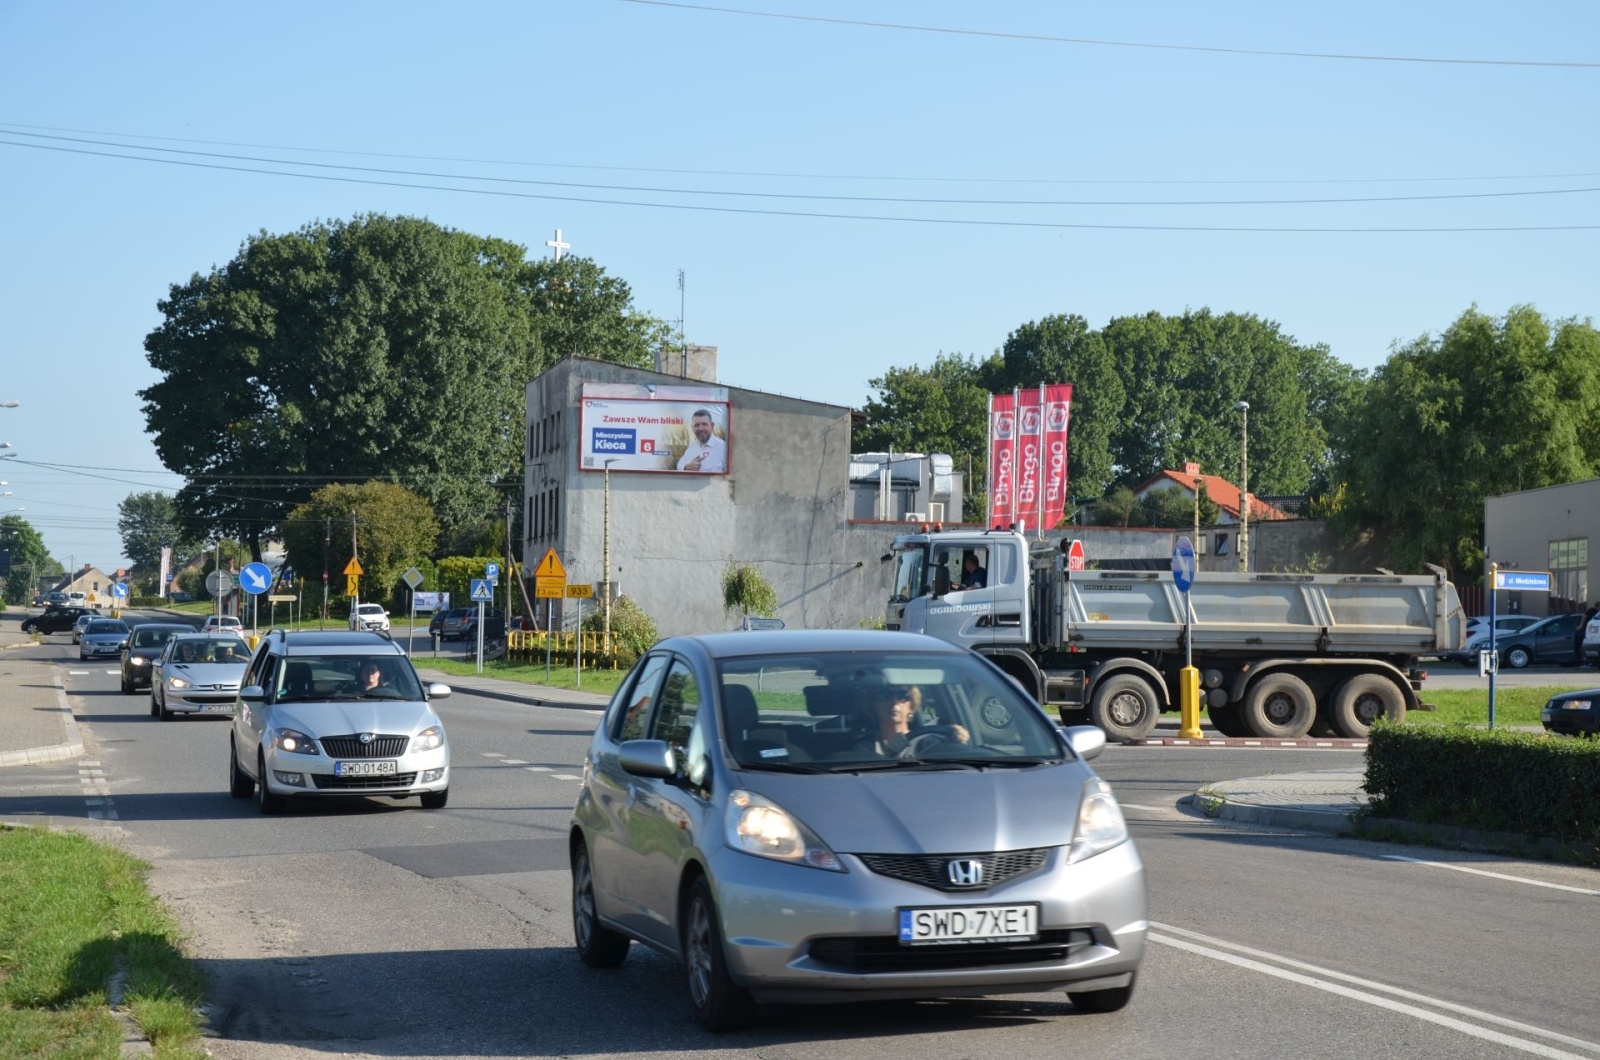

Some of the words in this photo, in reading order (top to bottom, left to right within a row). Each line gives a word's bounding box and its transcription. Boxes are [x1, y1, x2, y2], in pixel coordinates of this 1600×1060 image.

[603, 415, 636, 424] Zawsze
[638, 416, 659, 424] Wam
[660, 417, 684, 425] bliski
[595, 439, 626, 450] Kieca
[643, 442, 652, 452] 6
[995, 448, 1011, 506] Bingo
[1019, 443, 1038, 503] Bingo
[1071, 556, 1083, 570] STOP
[489, 565, 496, 574] P
[571, 586, 588, 596] 933
[930, 602, 991, 615] OGRODOWSKI
[341, 763, 361, 774] SWD
[363, 763, 395, 774] 0148A
[916, 912, 967, 937] SWD
[976, 908, 1030, 935] 7XE1
